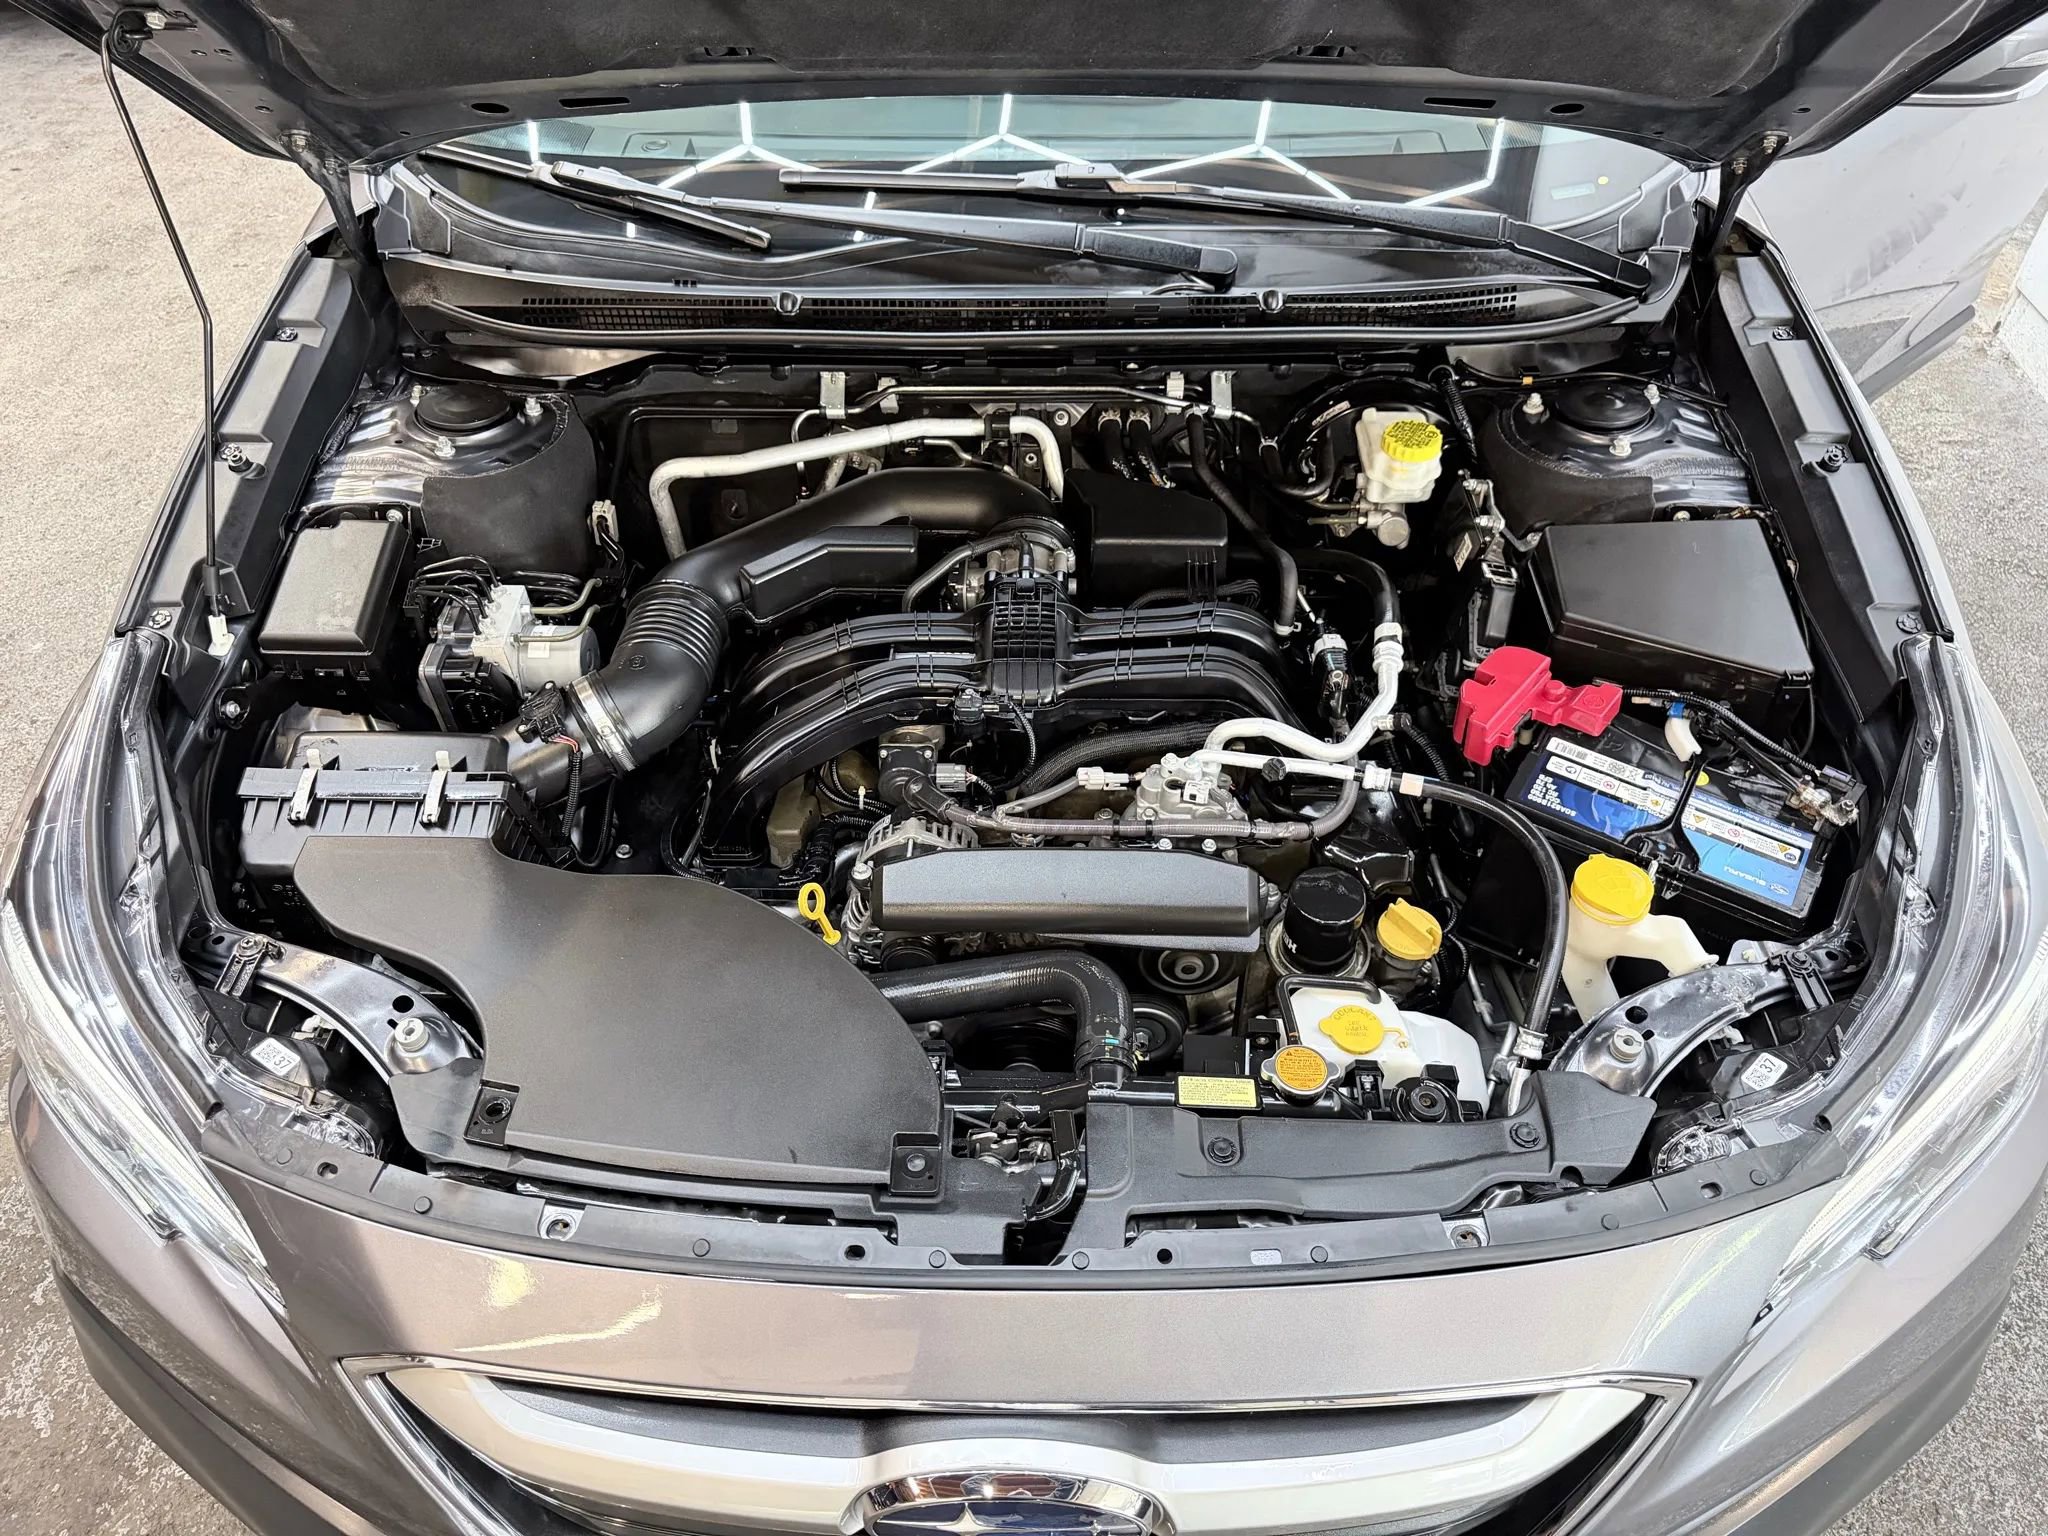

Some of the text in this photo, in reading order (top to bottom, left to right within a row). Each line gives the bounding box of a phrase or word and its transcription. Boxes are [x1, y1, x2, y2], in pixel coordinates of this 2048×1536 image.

[1738, 809, 1759, 820] Subaru
[1770, 822, 1801, 837] Distributed
[1723, 865, 1766, 886] SUBARU
[273, 1056, 292, 1070] 37
[1759, 1057, 1776, 1073] 37
